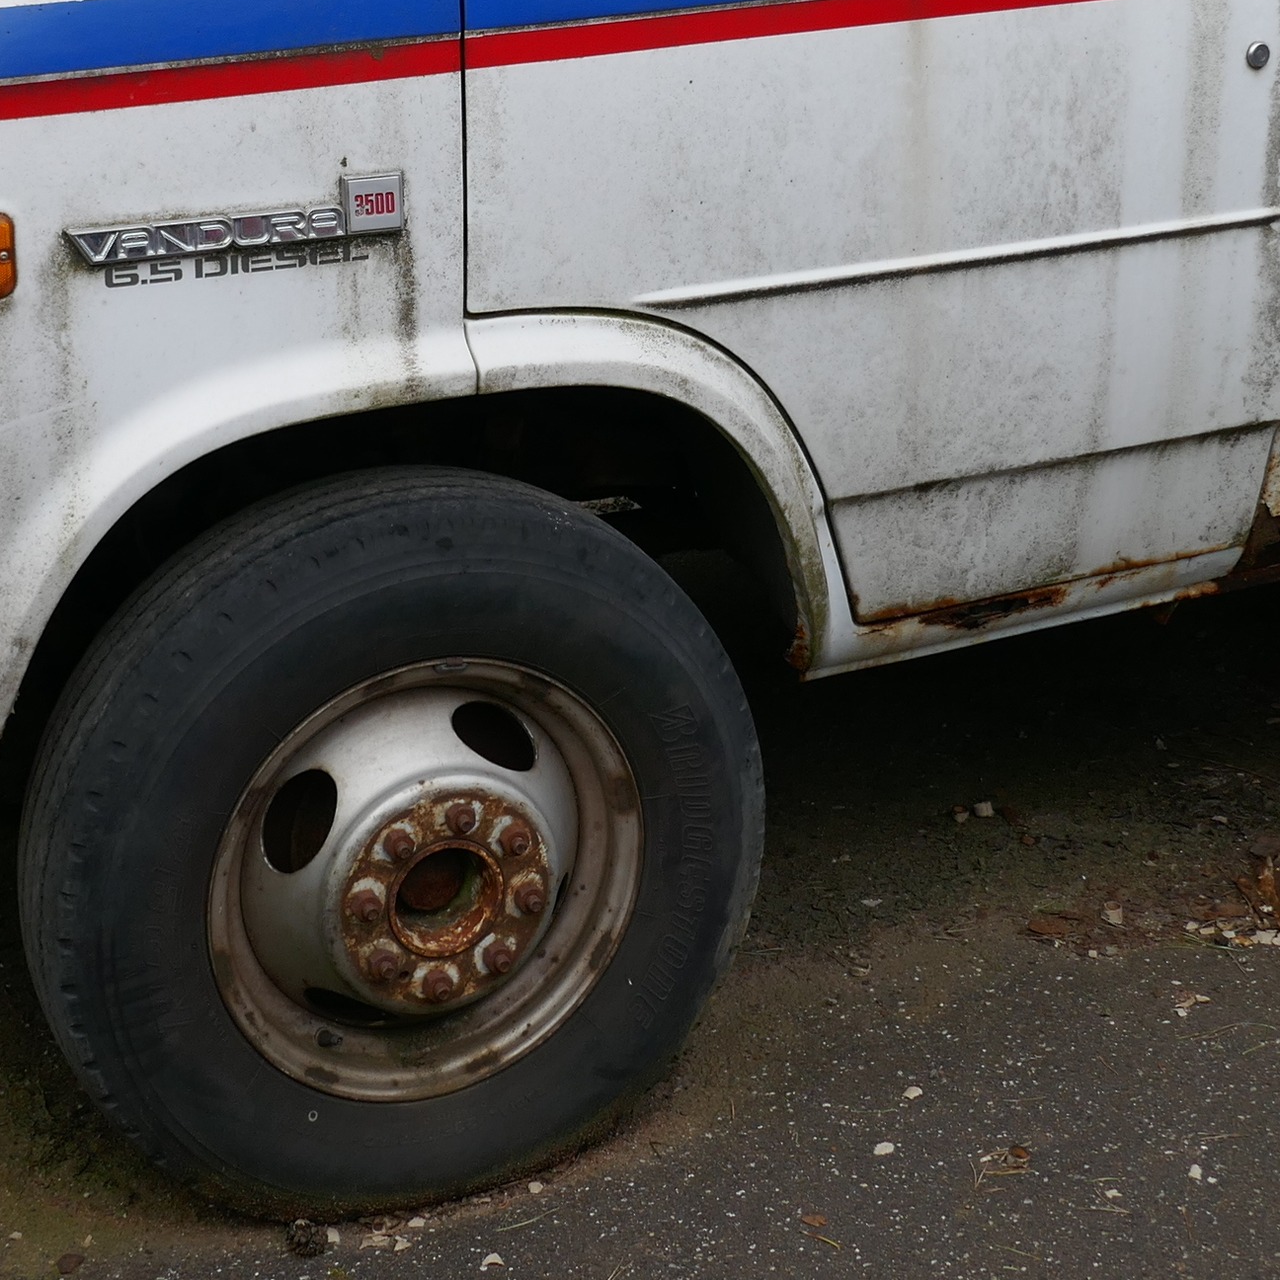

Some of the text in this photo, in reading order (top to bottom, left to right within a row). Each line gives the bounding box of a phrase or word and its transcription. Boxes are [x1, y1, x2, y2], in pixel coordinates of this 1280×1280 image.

[353, 190, 396, 217] 3500
[63, 205, 346, 265] VANDURA
[104, 242, 370, 289] 6.5 DIESEL
